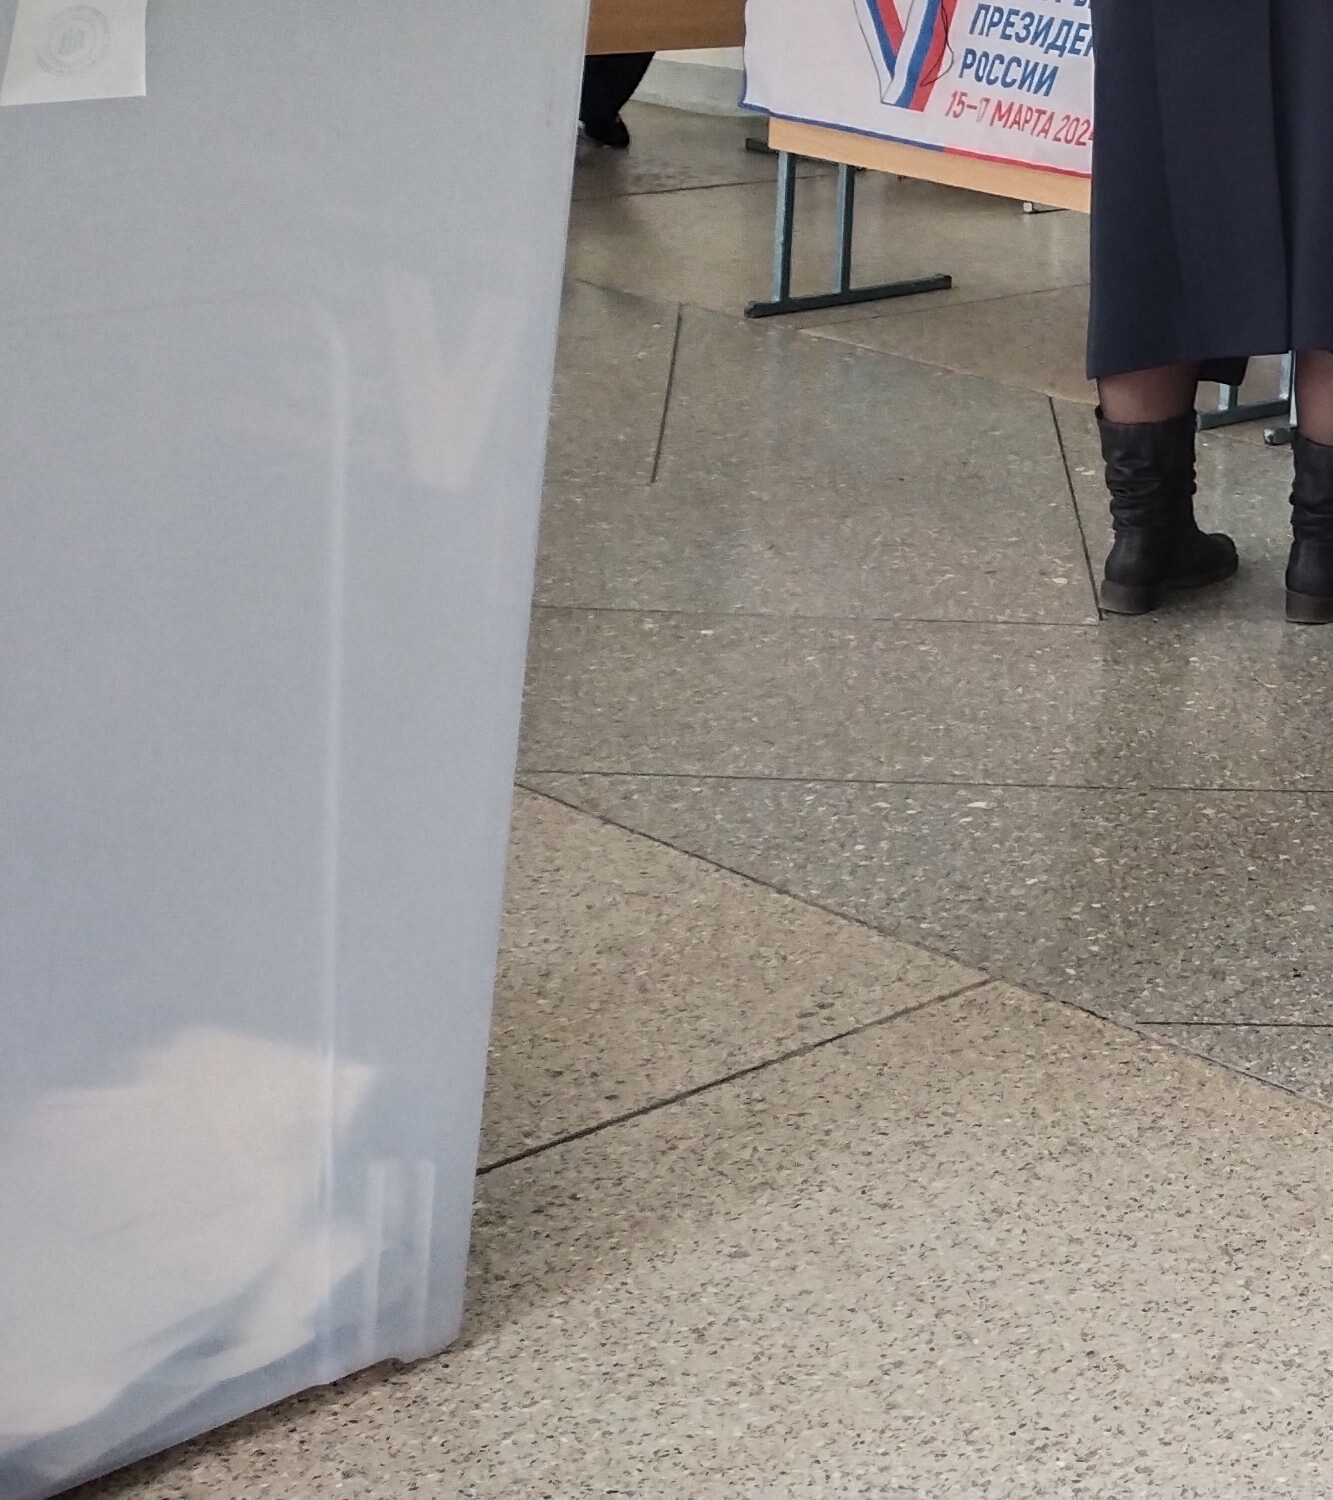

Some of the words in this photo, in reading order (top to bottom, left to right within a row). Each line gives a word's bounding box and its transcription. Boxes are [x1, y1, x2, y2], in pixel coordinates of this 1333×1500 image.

[969, 3, 1094, 58] ПРЕЗИДЕ
[958, 48, 1059, 97] РОССИИ
[990, 100, 1055, 140] МАРТА
